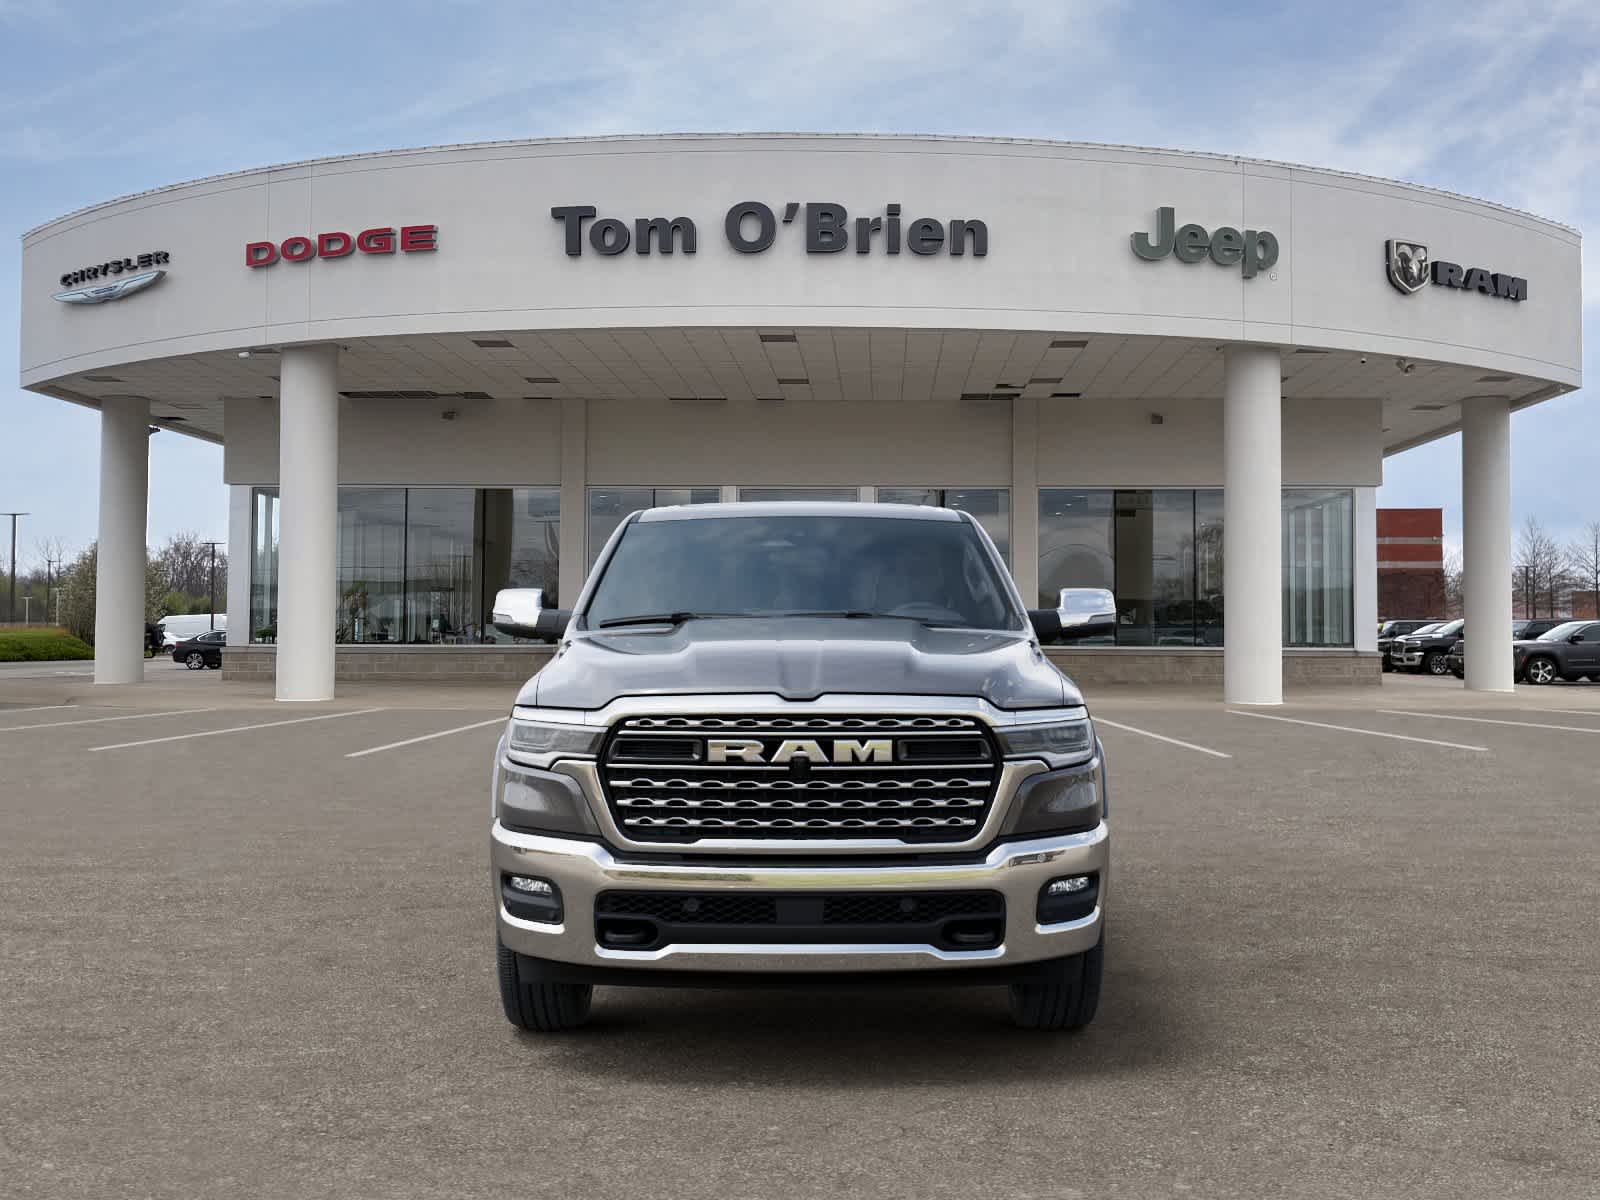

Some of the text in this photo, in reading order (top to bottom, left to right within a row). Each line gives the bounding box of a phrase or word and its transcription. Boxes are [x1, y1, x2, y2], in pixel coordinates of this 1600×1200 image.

[245, 225, 438, 269] DODGE
[551, 201, 988, 256] Tom O'Brien
[1130, 206, 1279, 278] Jeep
[60, 250, 170, 287] CHRYSLER
[1431, 260, 1528, 301] RAM
[706, 739, 893, 763] RAM
